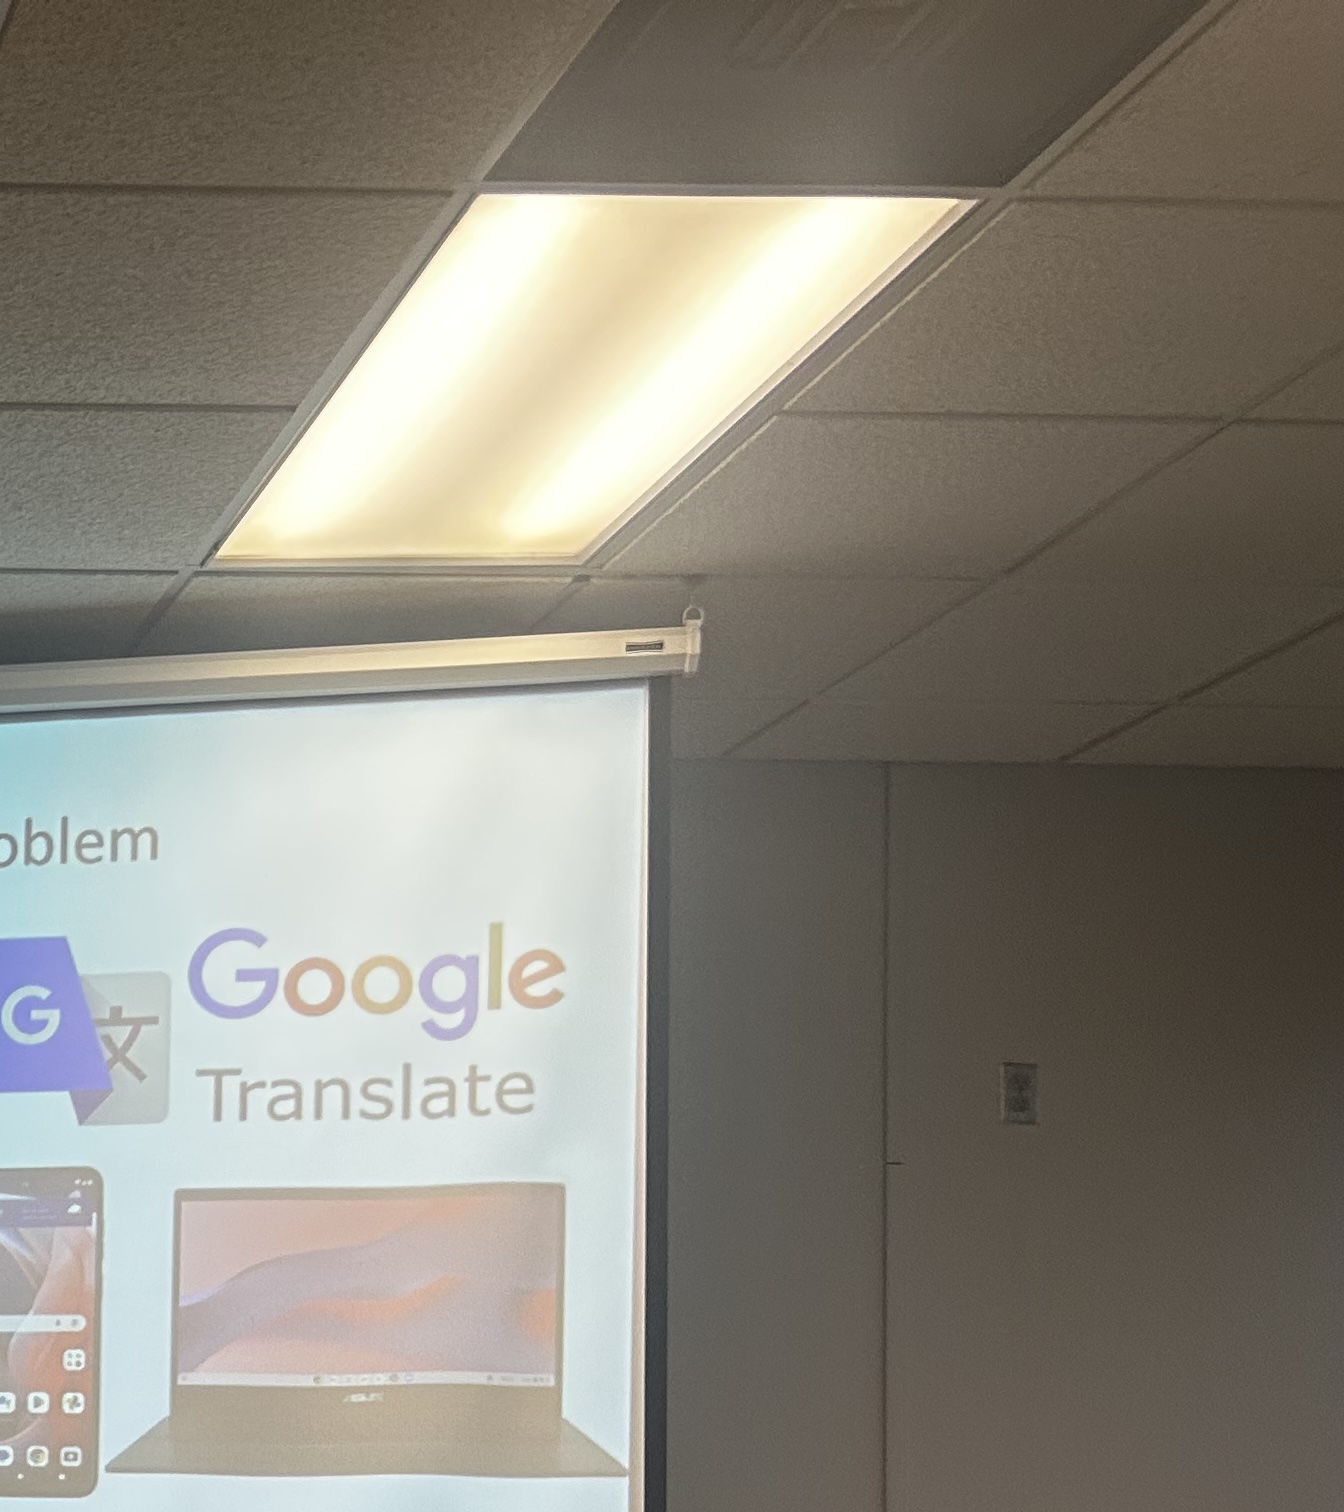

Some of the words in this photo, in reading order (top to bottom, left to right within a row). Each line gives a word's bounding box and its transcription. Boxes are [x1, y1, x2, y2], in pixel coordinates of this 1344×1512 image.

[187, 921, 567, 1042] Google
[0, 985, 61, 1045] G
[195, 1063, 536, 1122] Translate
